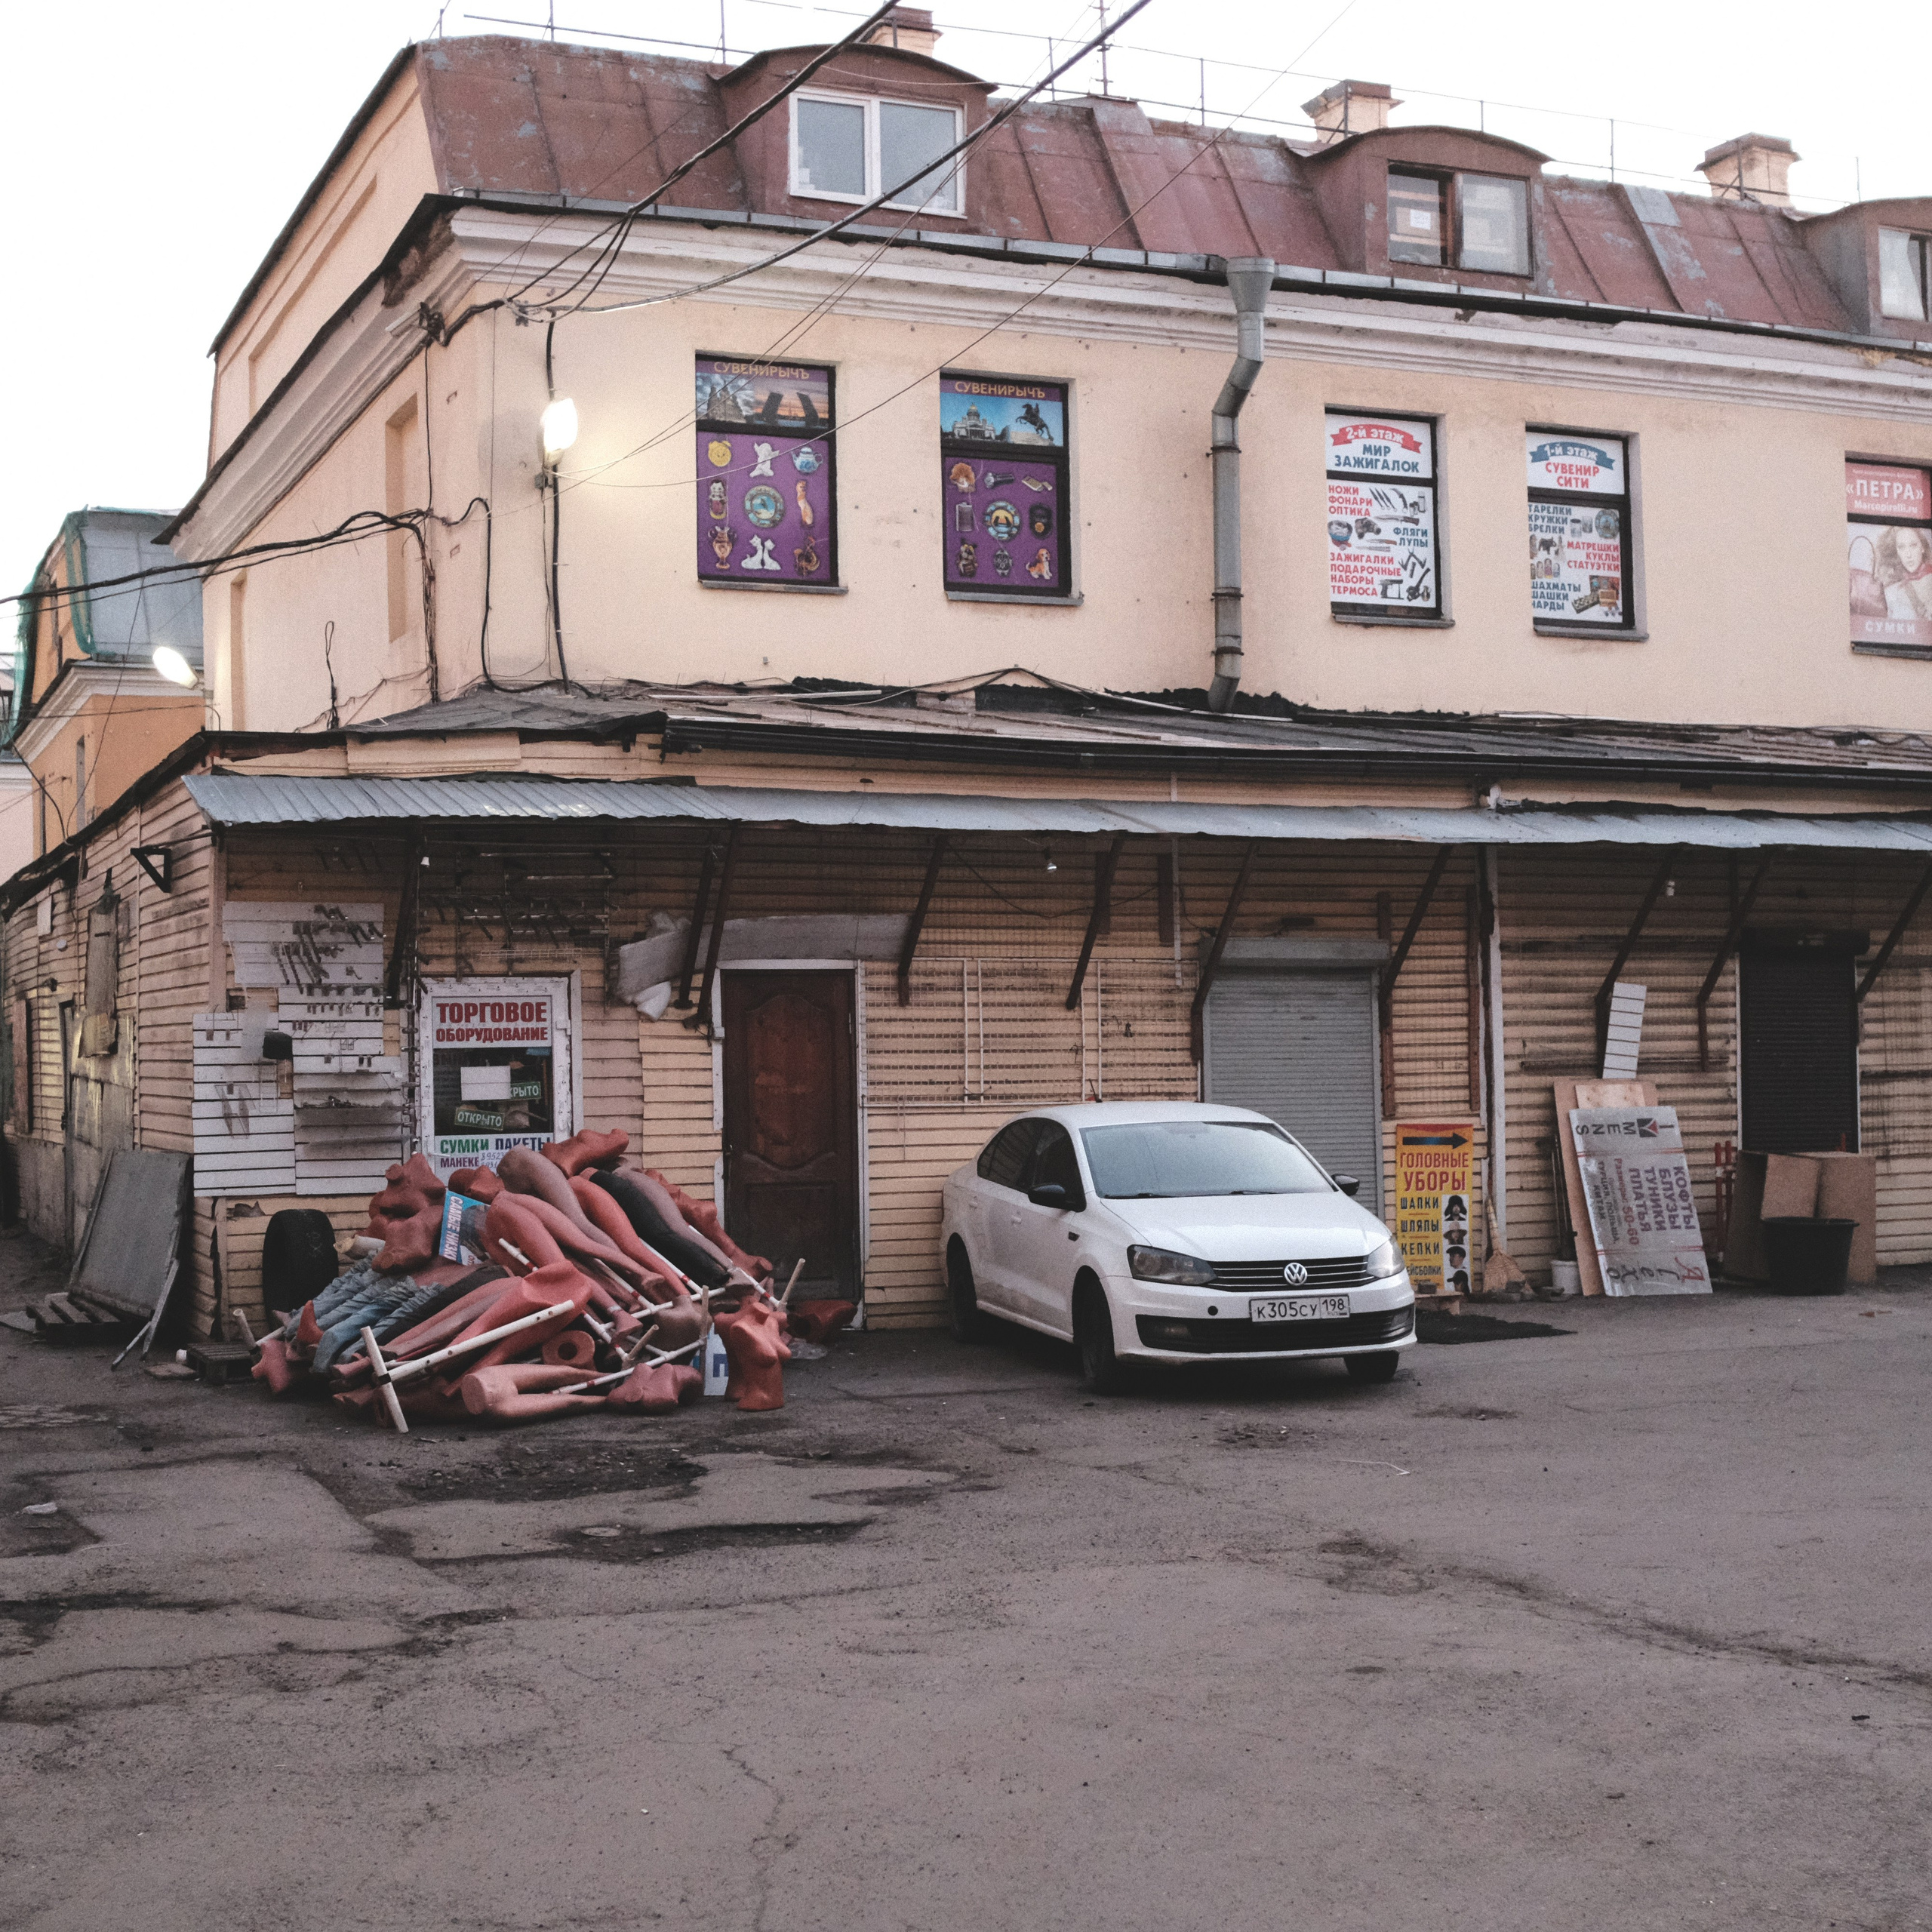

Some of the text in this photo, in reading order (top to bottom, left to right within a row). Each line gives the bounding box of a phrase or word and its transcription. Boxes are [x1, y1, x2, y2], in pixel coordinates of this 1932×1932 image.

[713, 361, 810, 380] СУВЕНИРЫЧЪ
[954, 381, 1046, 398] СУВЕНИРЫЧЪ
[1346, 426, 1404, 445] 2-й этаж
[1362, 444, 1392, 457] МИР
[1544, 444, 1598, 461] 1-й этаж
[1334, 455, 1420, 473] ЗАЖИГАЛОК
[1545, 462, 1600, 477] СУВЕНИР
[1556, 475, 1589, 489] СИТИ
[1328, 485, 1359, 495] НОЖИ
[1328, 495, 1373, 506] ФОНАРИ
[1328, 506, 1371, 517] ОПТИКА
[1528, 504, 1572, 515] ТАРЕЛКИ
[1528, 514, 1568, 525] КРУЖКИ
[1393, 527, 1428, 537] ФЛЯГИ
[1398, 537, 1429, 548] ЛУПЫ
[1567, 540, 1620, 552] МАТРЕШКИ
[1330, 552, 1394, 565] ЗАЖИГАЛКИ
[1586, 552, 1620, 562] КУКЛЫ
[1331, 564, 1401, 577] ПОДАРОЧНЫЕ
[1567, 560, 1620, 572] СТАТУЭТКИ
[1331, 574, 1374, 585] НАБОРЫ
[1531, 581, 1581, 592] ШАХМАТЫ
[1331, 585, 1378, 596] ТЕРМОСА
[1531, 591, 1569, 601] ШАШКИ
[1864, 620, 1915, 634] СУМКИ
[435, 1001, 547, 1023] ТОРГОВОЕ
[435, 1026, 548, 1044] ОБОРУДОВАНИЕ
[510, 1085, 540, 1099] КРЫТО
[457, 1111, 503, 1128] ОТКРЫТО
[440, 1138, 489, 1154] СУМКИ
[440, 1156, 479, 1168] МАНЕКЕ
[1399, 1152, 1469, 1168] ГОЛОВНЫЕ
[1403, 1171, 1466, 1192] УБОРЫ
[1400, 1196, 1439, 1210] ШАПКИ
[1628, 1168, 1651, 1232] ПЛАТЬЯ
[1642, 1167, 1666, 1232] ТУНИКИ
[1657, 1168, 1681, 1230] БЛУЗЫ
[1672, 1166, 1696, 1230] КОФТЫ
[448, 1196, 463, 1232] САМЫЕ
[1401, 1219, 1439, 1232] ШЛЯПЫ
[1621, 1206, 1639, 1246] 50-60
[1401, 1242, 1440, 1256] КЕПКИ
[1407, 1264, 1441, 1276] ЕЙСБОЛКИ
[1321, 1298, 1345, 1311] 198
